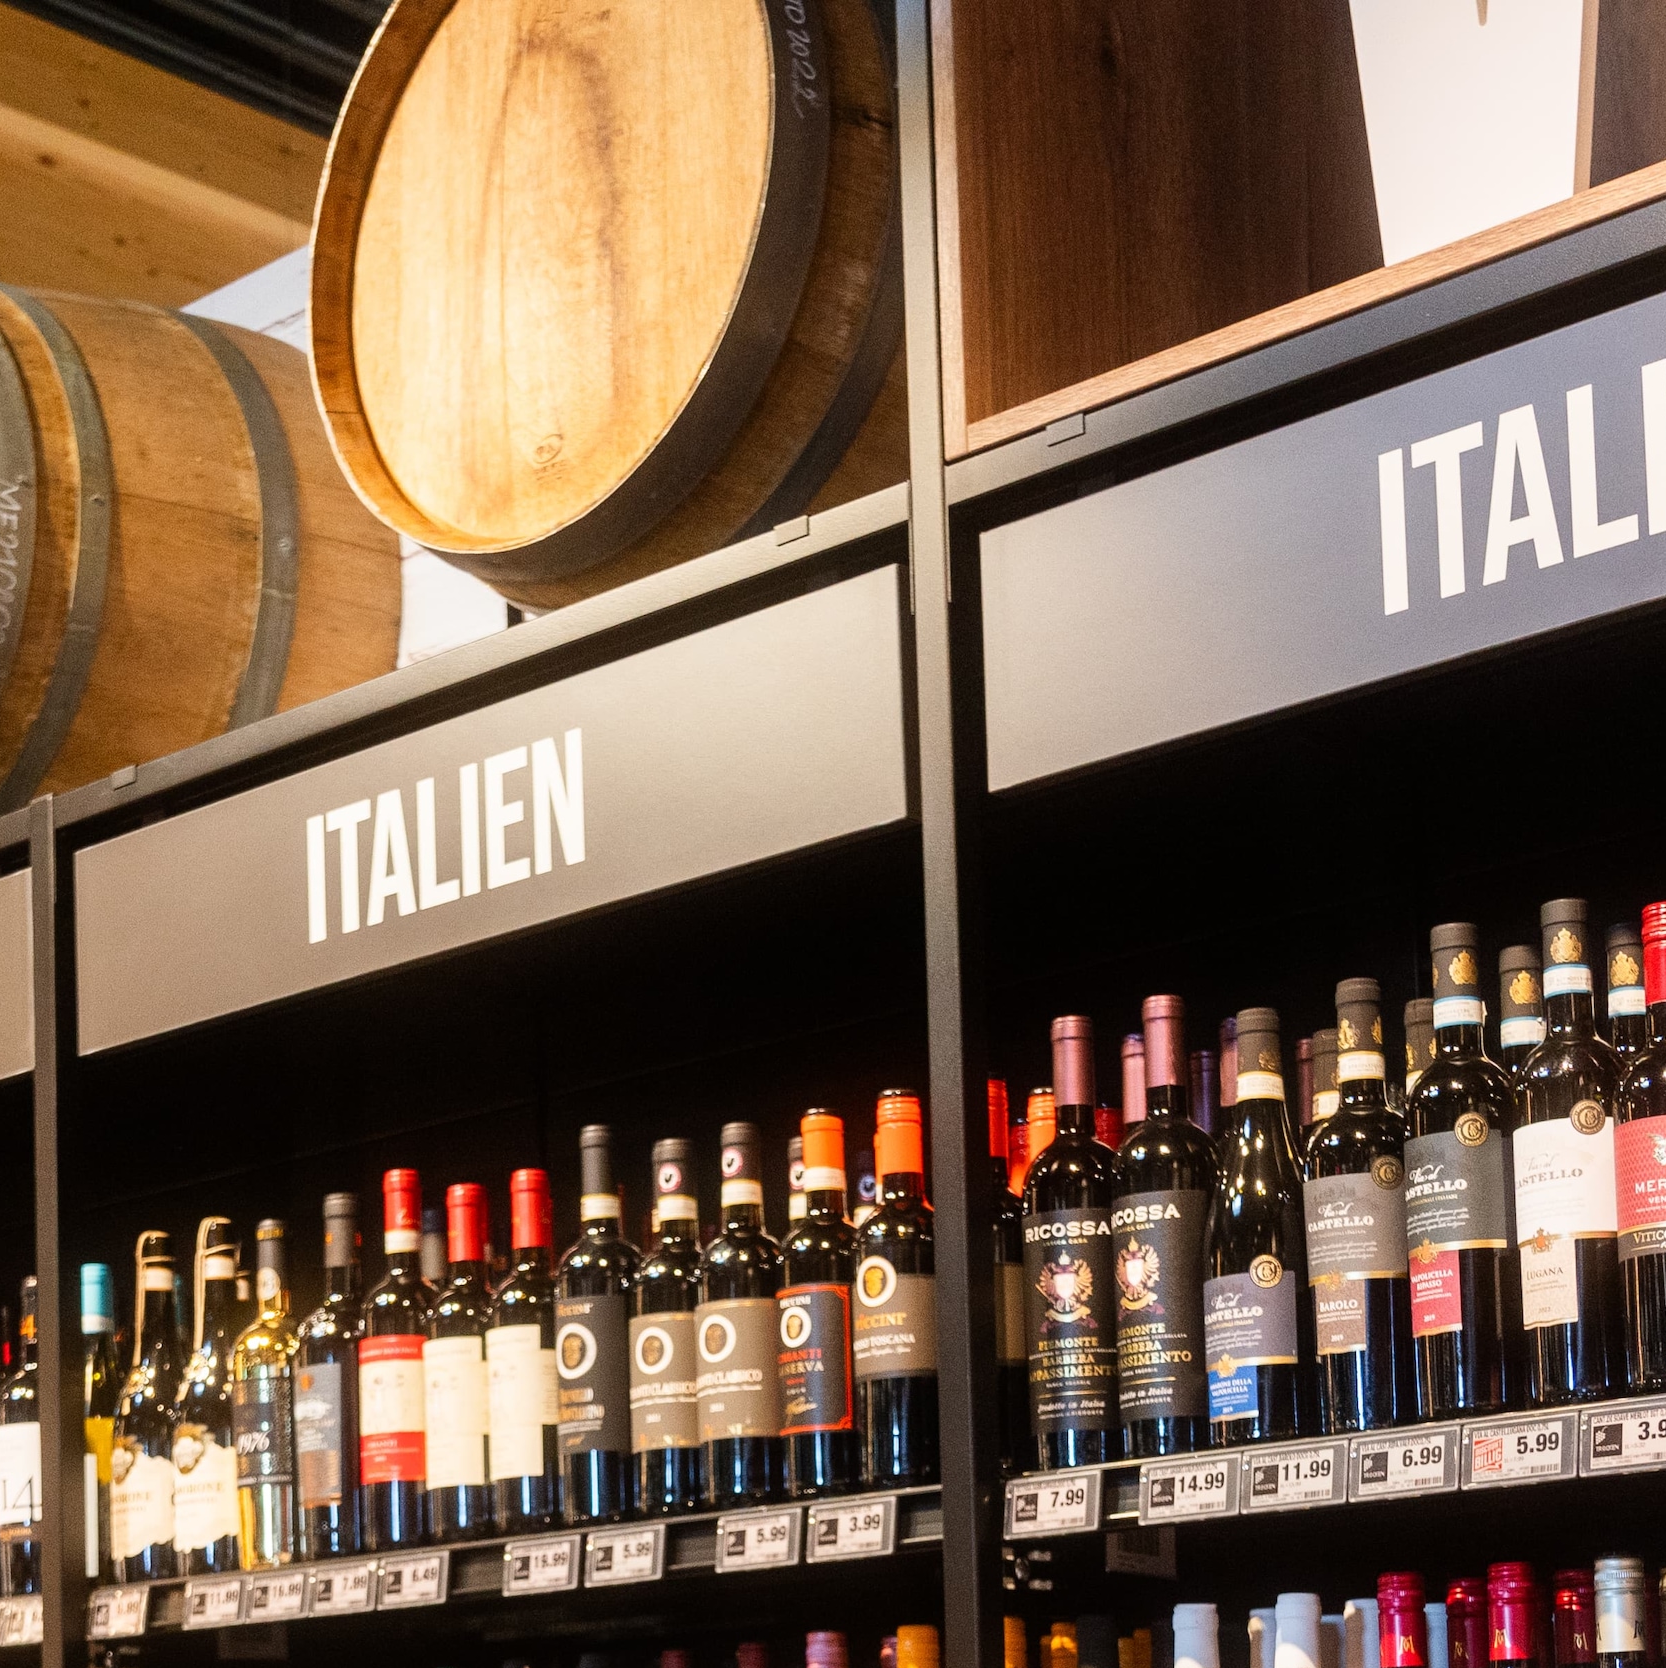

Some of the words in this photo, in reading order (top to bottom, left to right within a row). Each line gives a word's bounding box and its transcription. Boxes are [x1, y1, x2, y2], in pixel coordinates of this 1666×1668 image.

[305, 728, 585, 944] ITALIEN
[1025, 1220, 1111, 1243] RICOSSA
[1308, 1215, 1374, 1233] CASTELLO
[1320, 1299, 1358, 1311] BAROLO
[1517, 1432, 1559, 1454] 5.99
[1401, 1445, 1443, 1468] 6.99
[1474, 1450, 1502, 1471] BILLIG
[1282, 1459, 1331, 1483] 11.99
[1177, 1472, 1225, 1495] 14.99
[1050, 1488, 1085, 1508] 7.99
[849, 1513, 881, 1532] 3.99
[757, 1525, 787, 1543] 5.99
